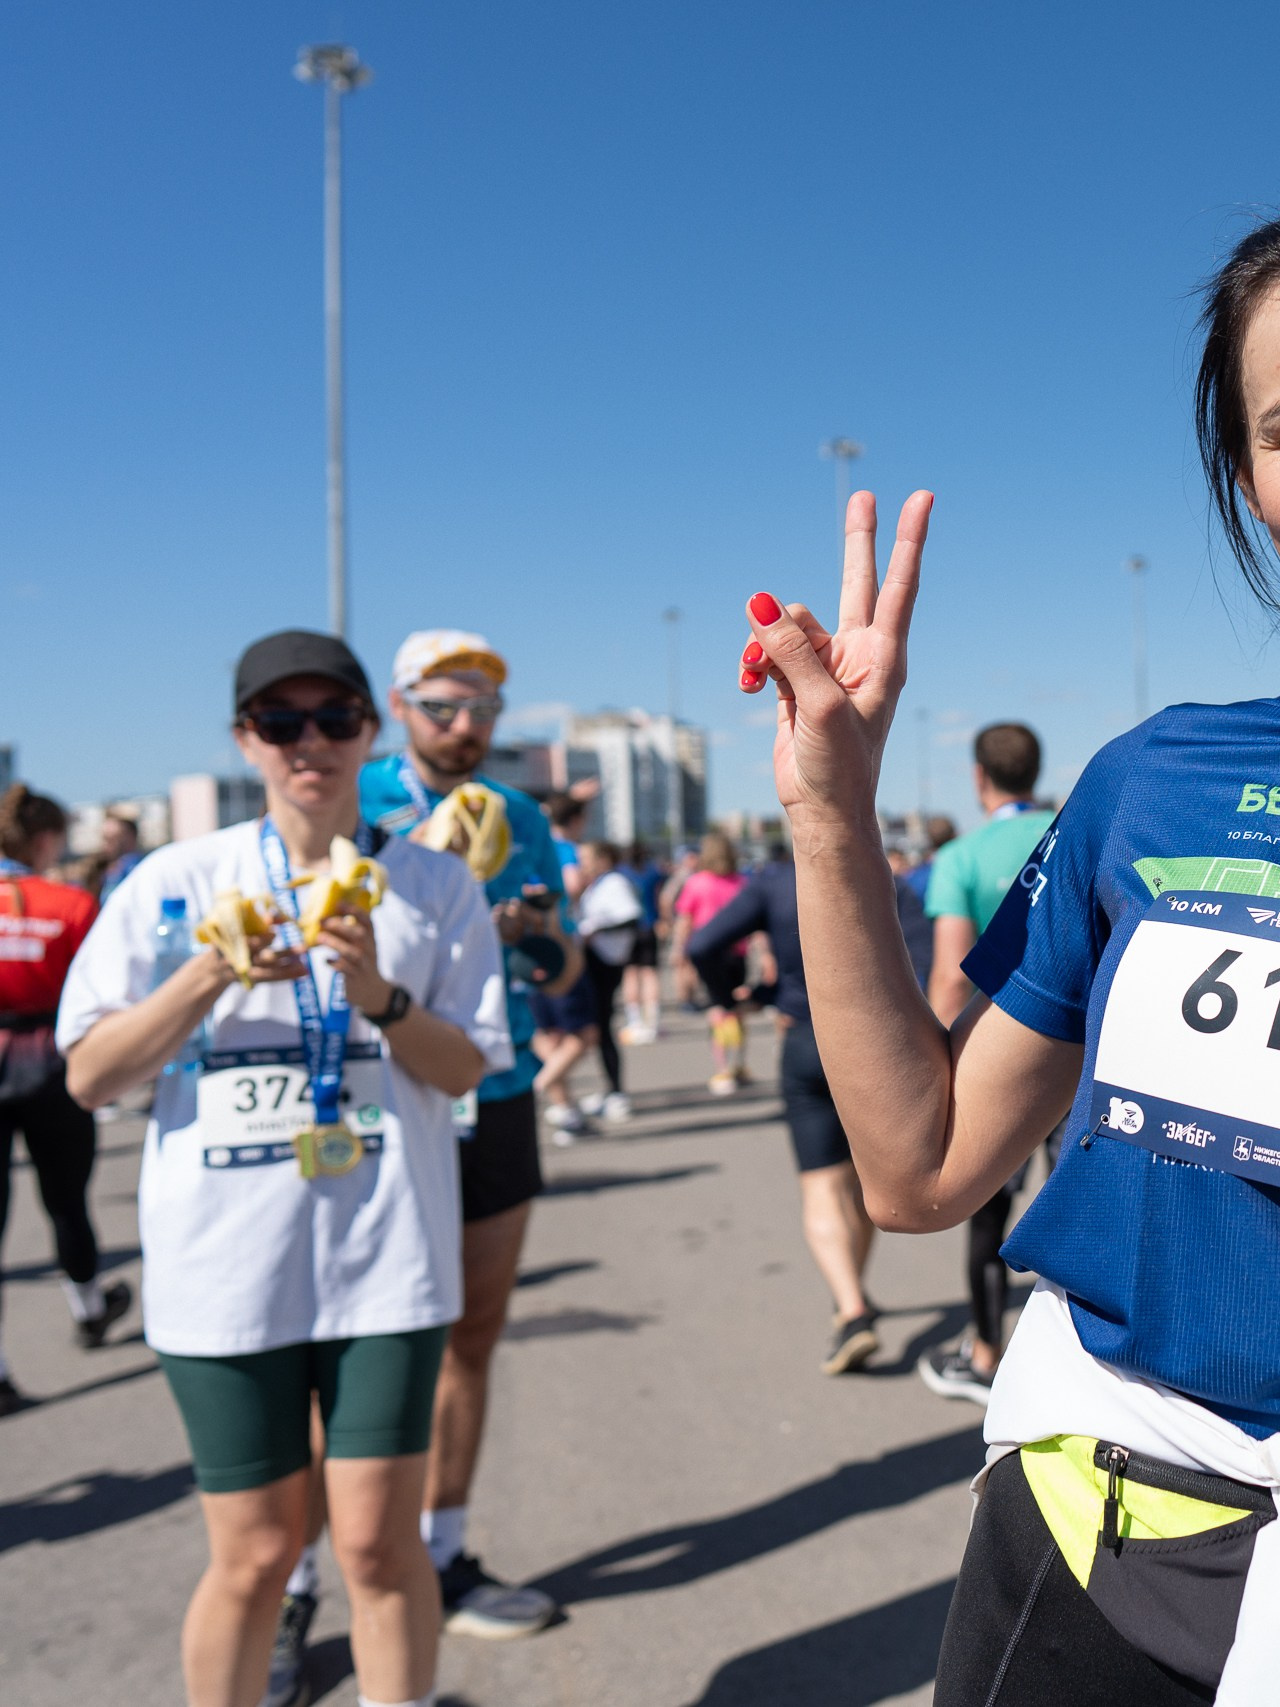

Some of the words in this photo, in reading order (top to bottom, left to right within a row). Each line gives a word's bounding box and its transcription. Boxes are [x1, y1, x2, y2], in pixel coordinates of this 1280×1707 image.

[1227, 831, 1241, 840] 10
[1169, 901, 1186, 912] 10
[1190, 902, 1223, 916] КМ
[1108, 1096, 1145, 1134] 10
